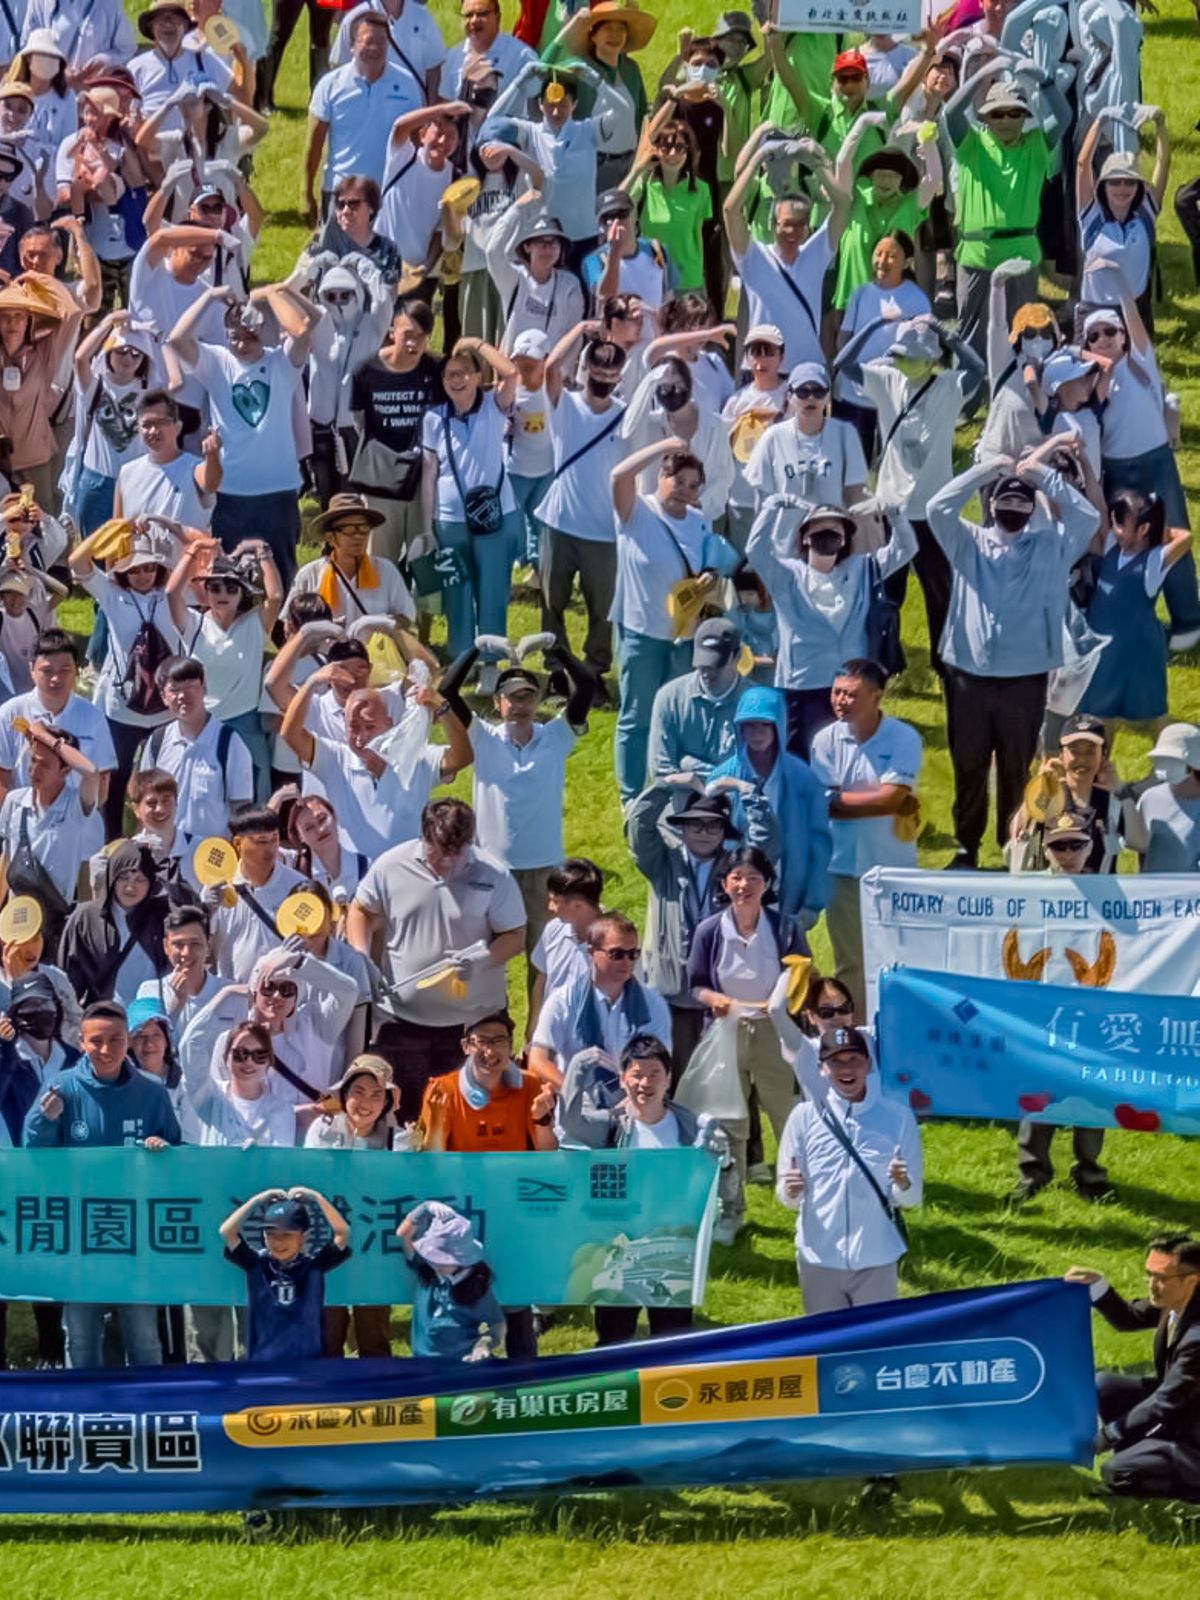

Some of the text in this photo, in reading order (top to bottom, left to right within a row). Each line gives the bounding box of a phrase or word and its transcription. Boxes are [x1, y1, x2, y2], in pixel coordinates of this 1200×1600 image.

[891, 892, 943, 914] ROTARY
[957, 896, 994, 917] CLUB
[1007, 898, 1026, 919] OF
[1041, 899, 1089, 919] TAIPEI
[1102, 900, 1162, 920] GOLDEN
[493, 1390, 629, 1420] 有巢氏房屋
[698, 1374, 804, 1405] 永義房屋
[876, 1358, 1019, 1392] 台慶不動產
